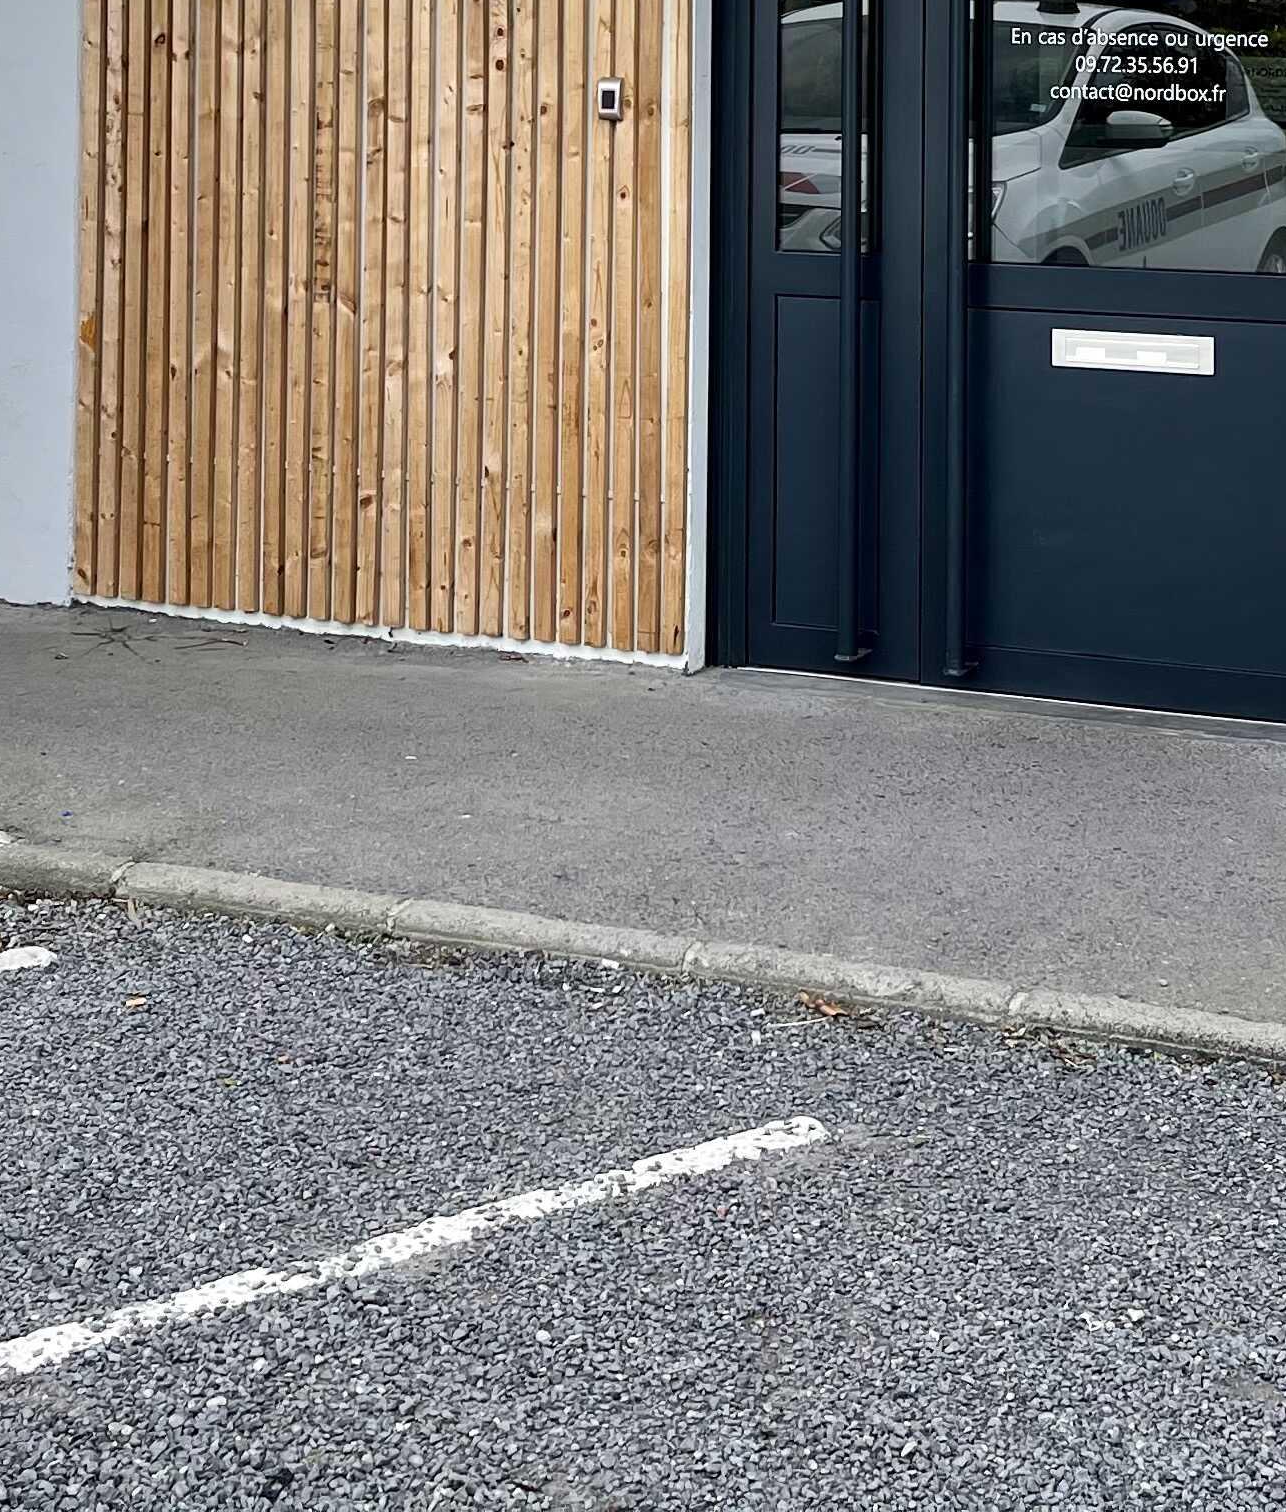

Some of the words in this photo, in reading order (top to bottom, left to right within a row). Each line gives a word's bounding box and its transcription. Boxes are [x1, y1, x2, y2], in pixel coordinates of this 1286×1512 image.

[1011, 26, 1033, 45] En
[1038, 30, 1066, 46] cas
[1071, 25, 1159, 47] d'absence
[1164, 32, 1189, 47] ou
[1195, 31, 1269, 52] urgence
[1074, 55, 1198, 75] 09.72.35.56.91
[1049, 82, 1227, 103] contact@nordbox.fr
